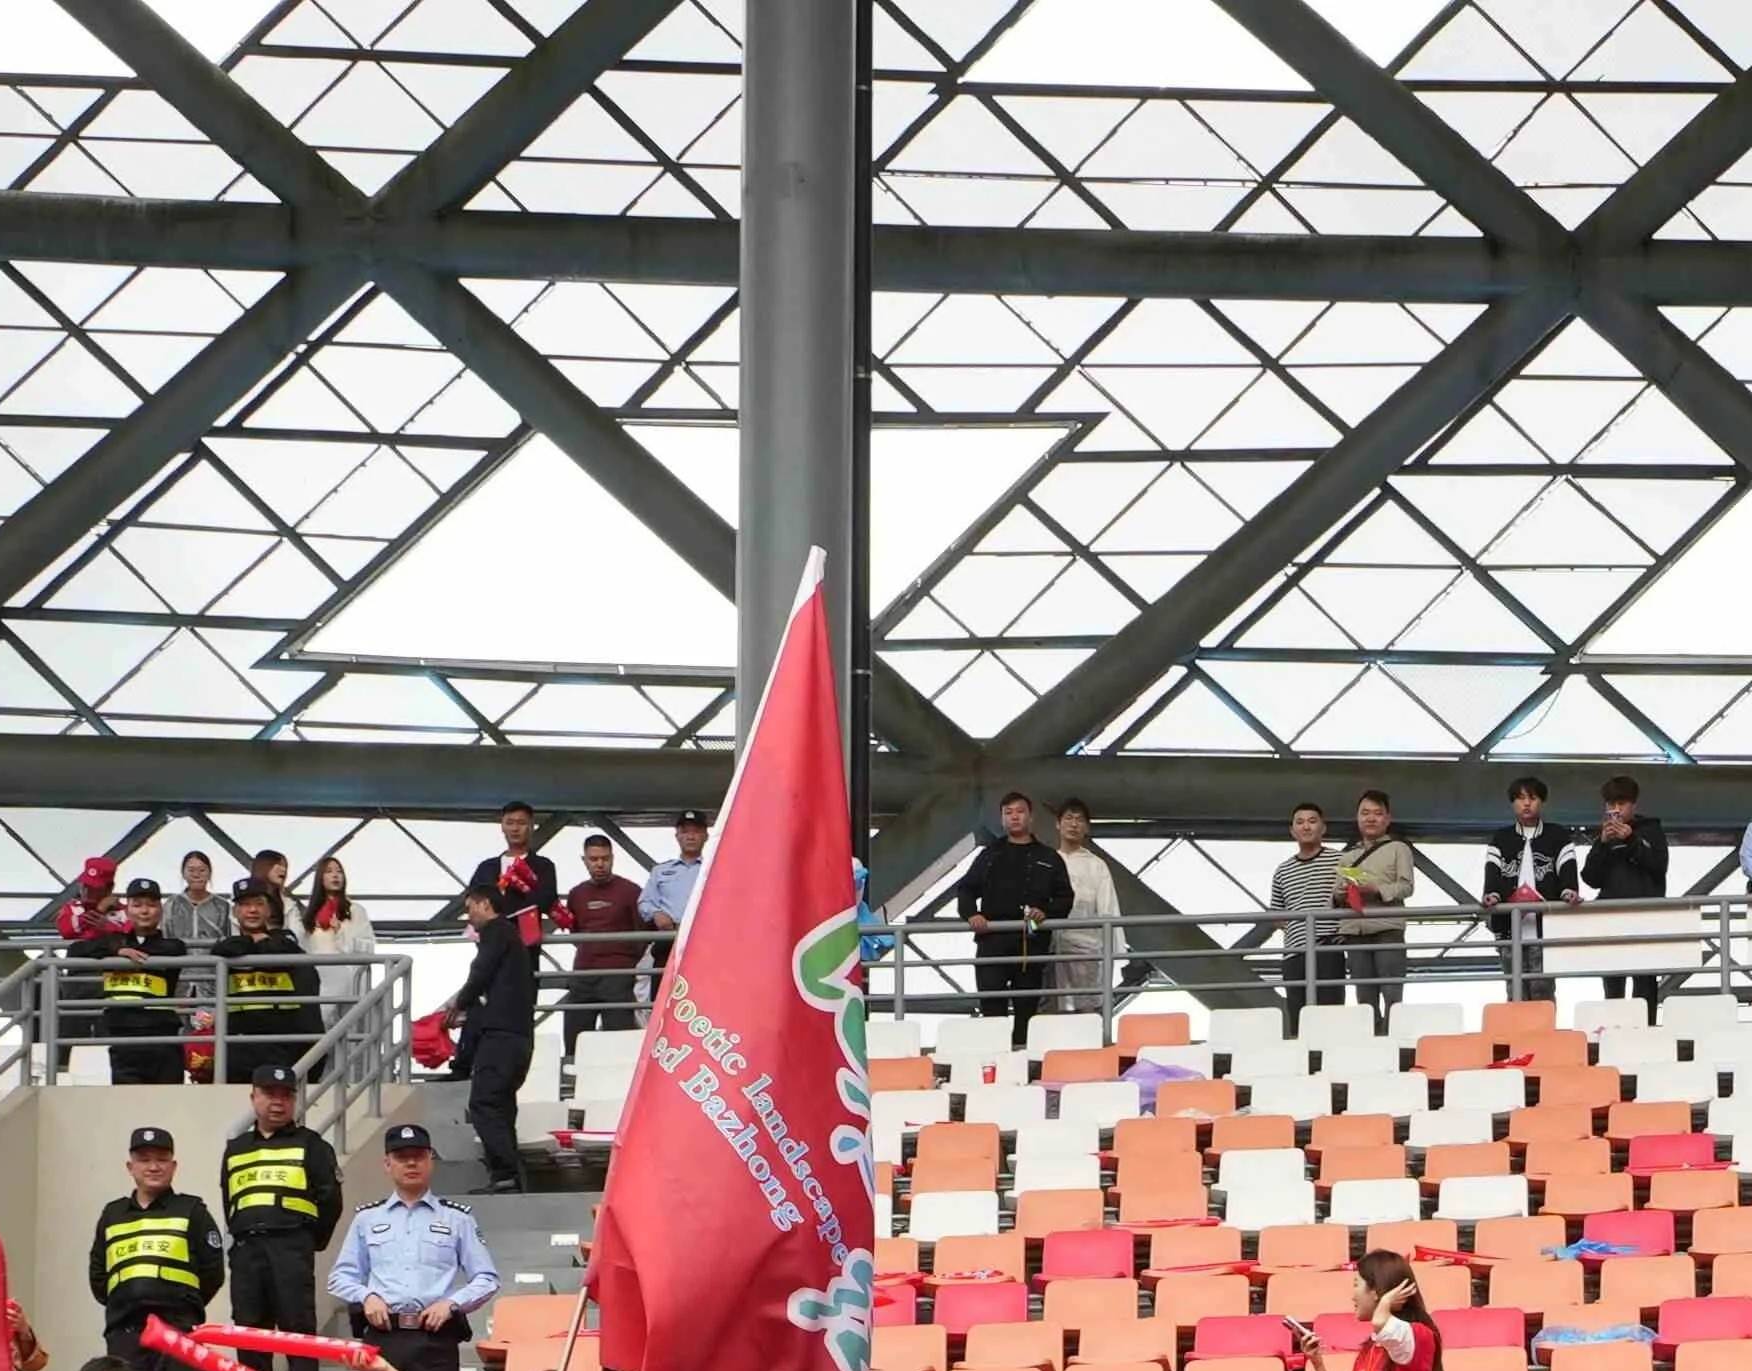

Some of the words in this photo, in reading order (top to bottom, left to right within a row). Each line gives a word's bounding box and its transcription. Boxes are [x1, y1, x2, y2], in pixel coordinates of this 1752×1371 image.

[651, 1034, 690, 1075] ed
[678, 1062, 804, 1235] Bazhong
[741, 1072, 851, 1267] landscape
[113, 1238, 170, 1257] 亿城保安
